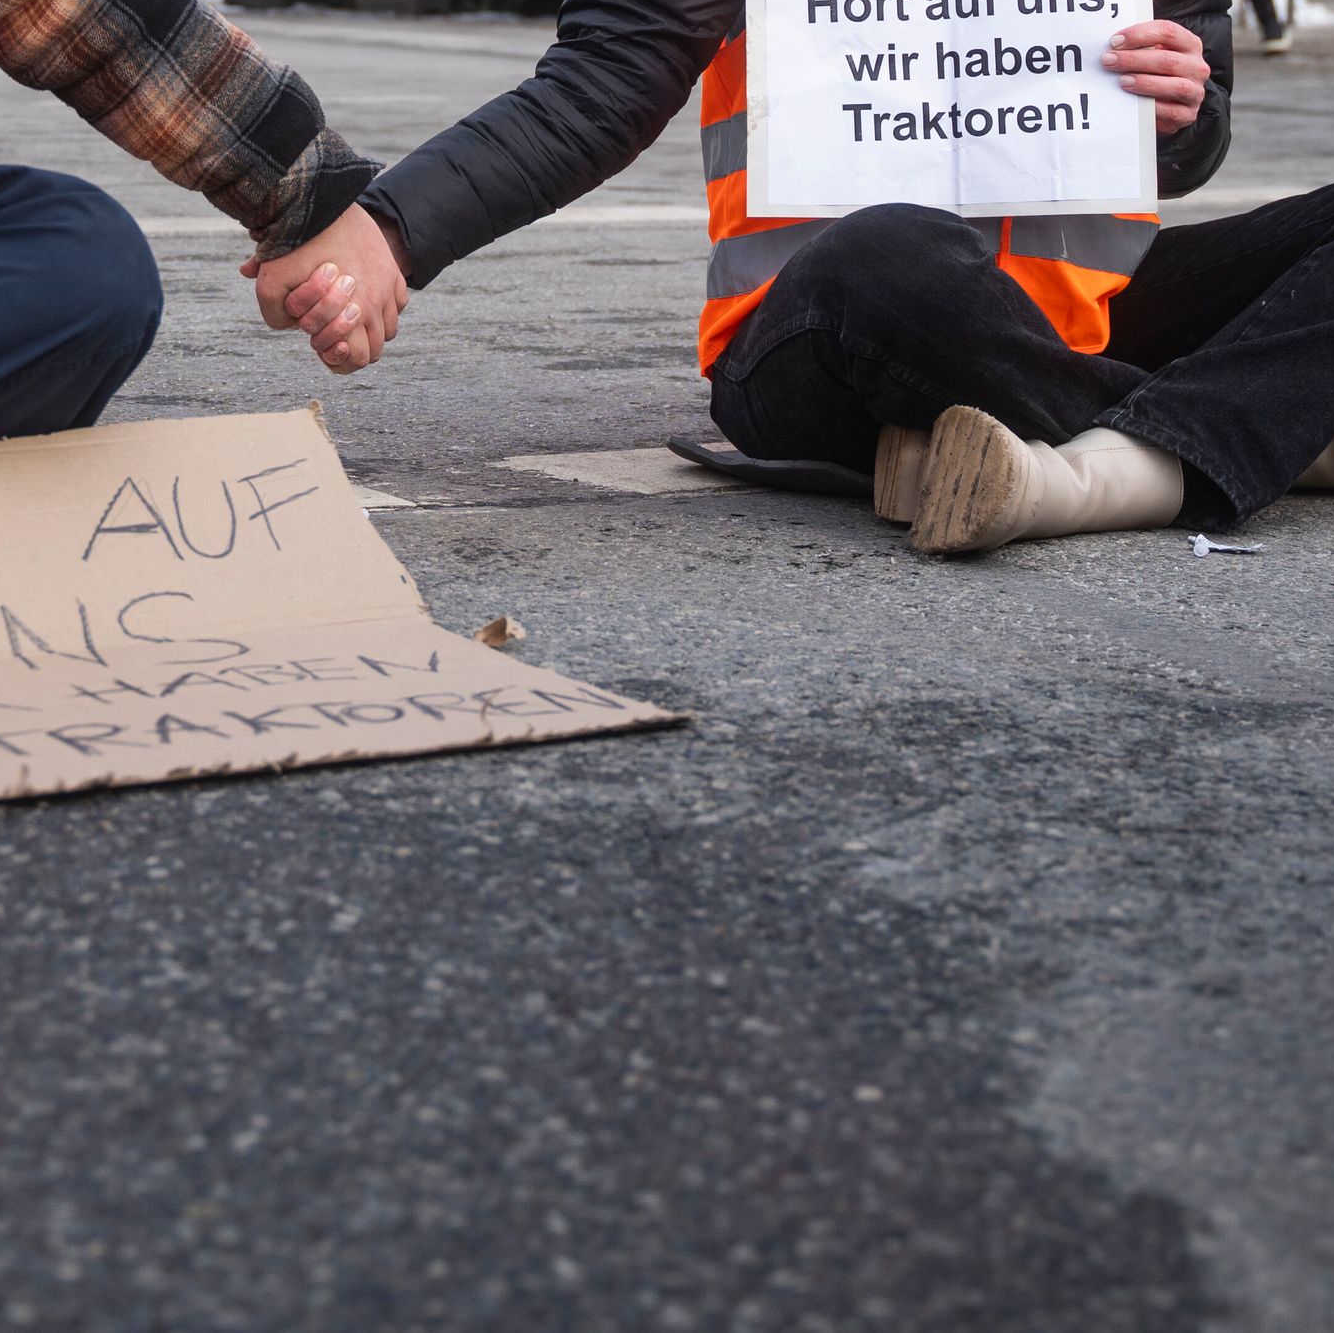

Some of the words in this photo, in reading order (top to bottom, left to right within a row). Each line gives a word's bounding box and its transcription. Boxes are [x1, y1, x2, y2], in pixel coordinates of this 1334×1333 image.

[845, 42, 918, 82] wir
[936, 36, 1083, 80] haben
[842, 93, 1091, 142] Traktoren!
[82, 457, 320, 562] AUF
[69, 650, 441, 706] HABEN
